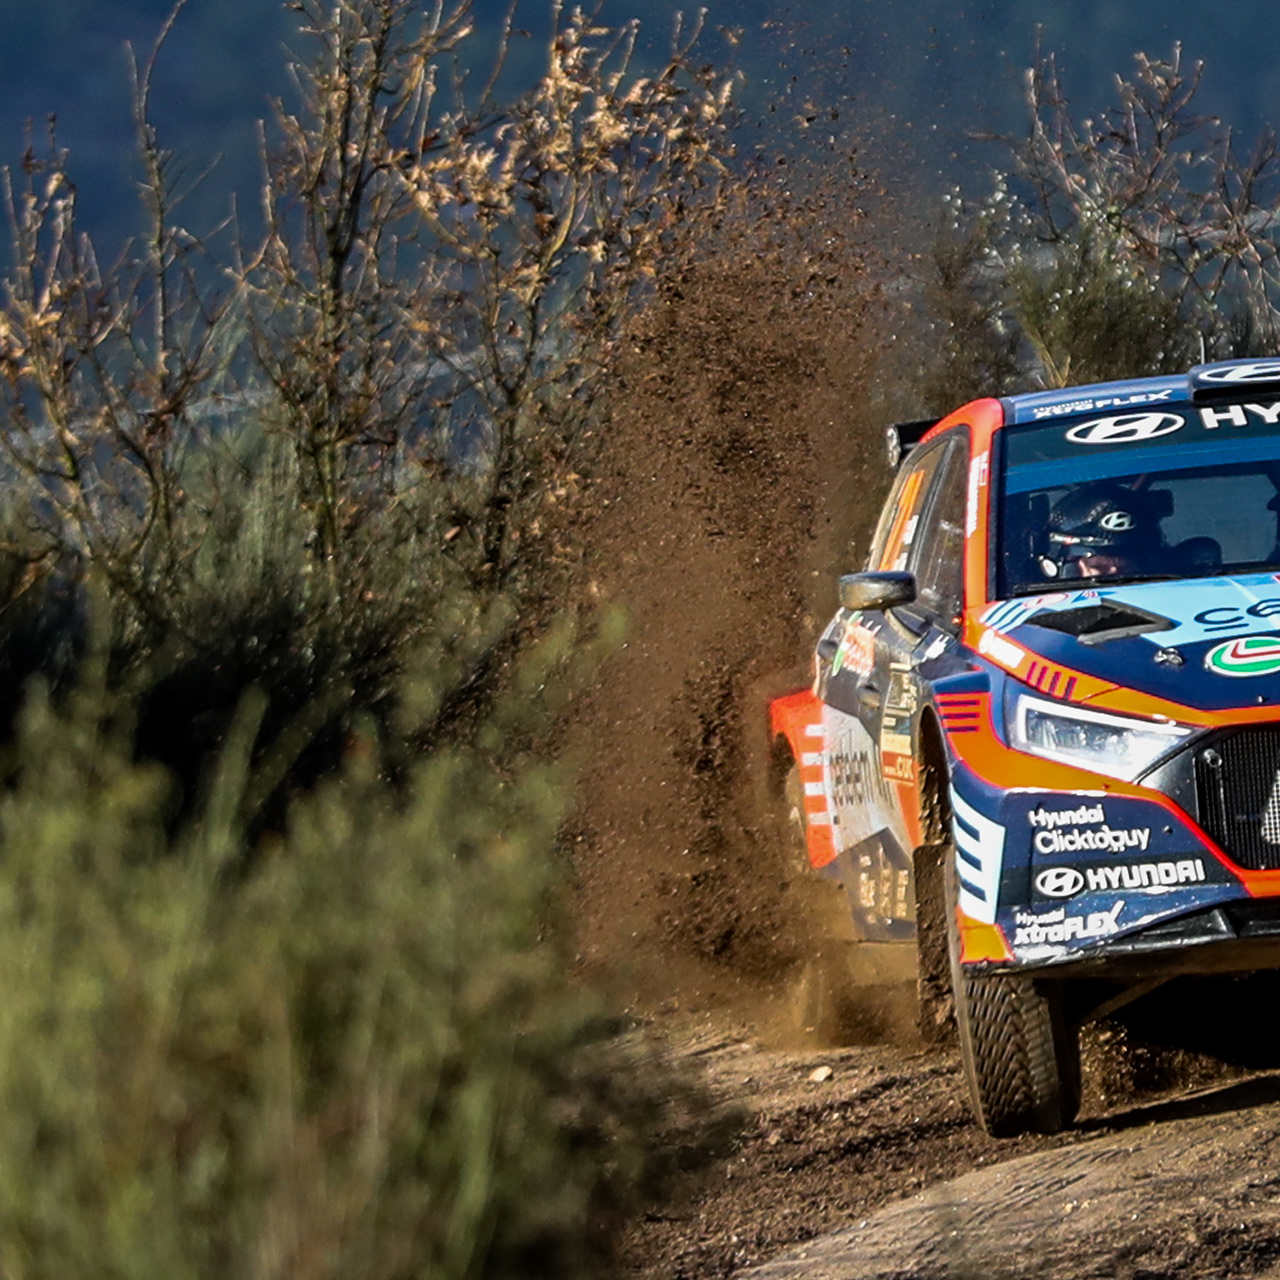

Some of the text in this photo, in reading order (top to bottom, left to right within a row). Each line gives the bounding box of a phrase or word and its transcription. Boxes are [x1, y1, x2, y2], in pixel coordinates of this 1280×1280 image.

[1028, 804, 1105, 828] Hyundai
[1034, 825, 1150, 854] Clicktobuy
[1086, 859, 1206, 891] HYUNDAI
[1013, 900, 1126, 945] xtraFLEX
